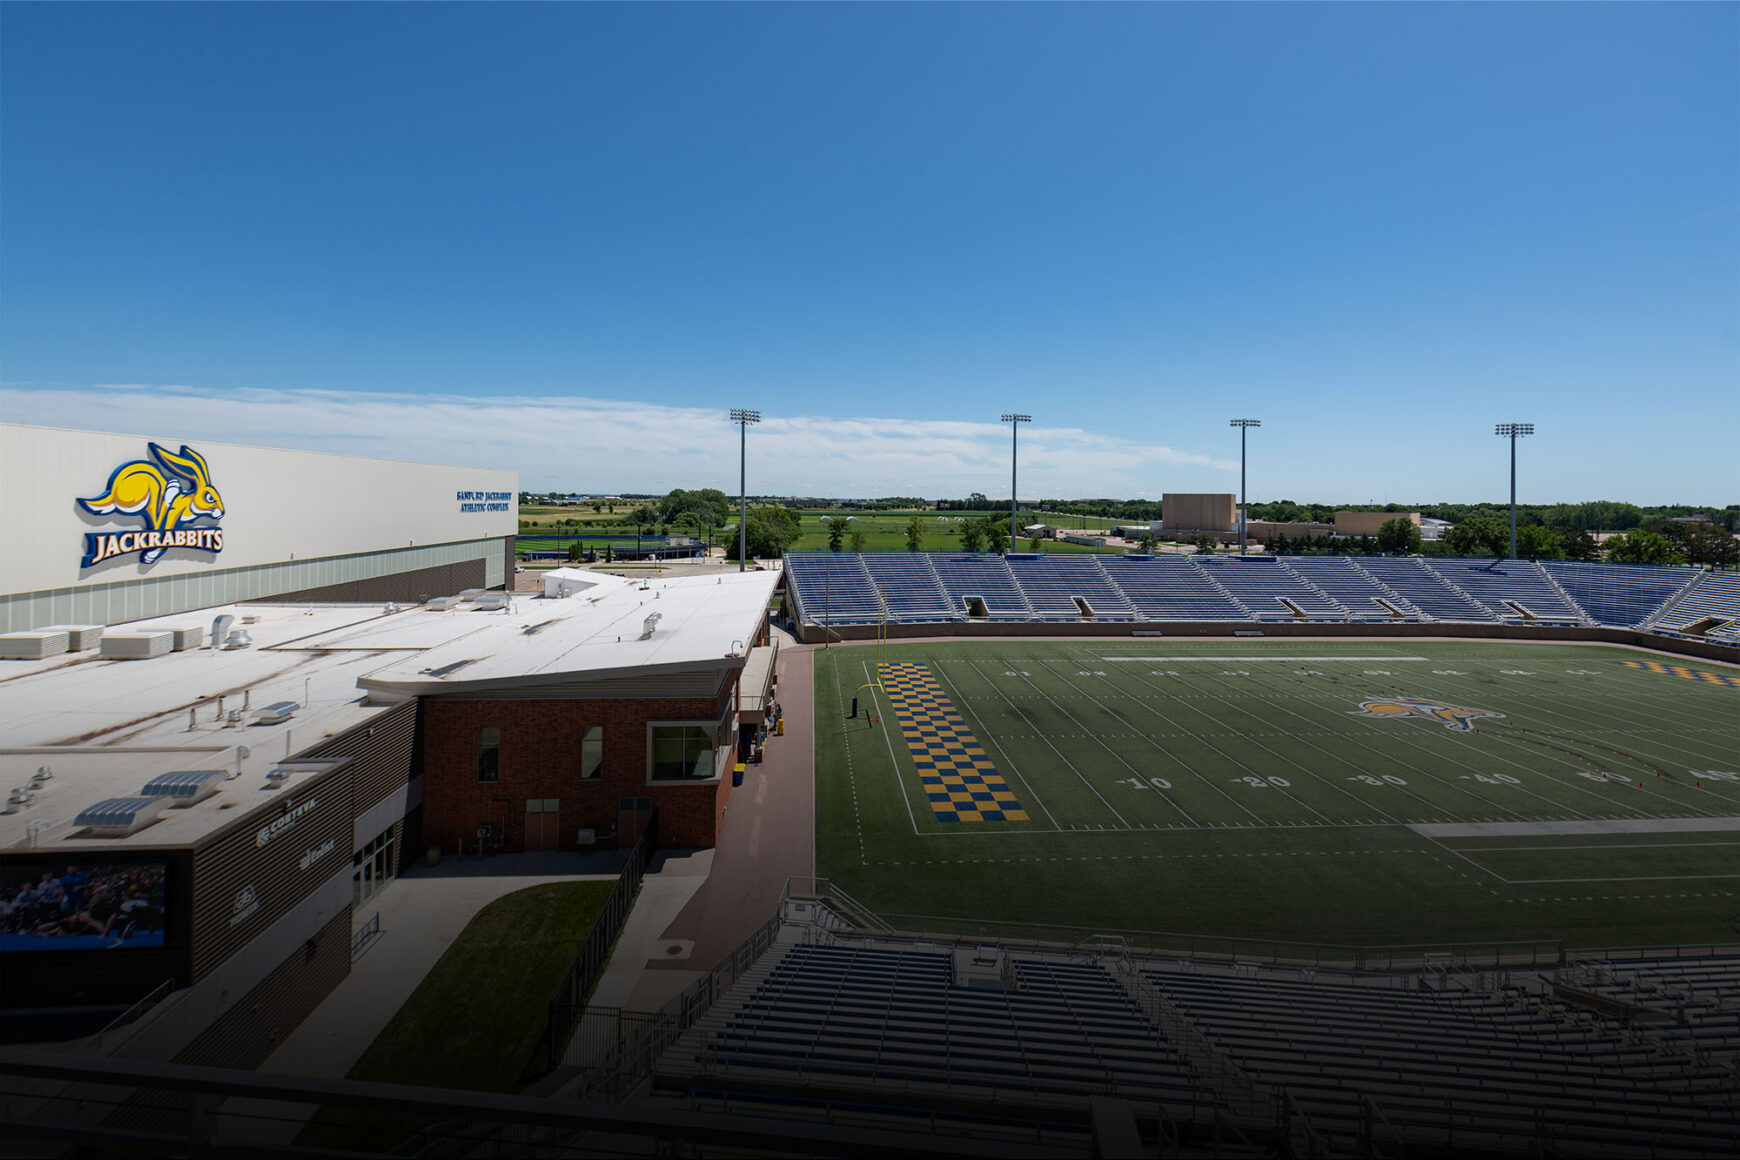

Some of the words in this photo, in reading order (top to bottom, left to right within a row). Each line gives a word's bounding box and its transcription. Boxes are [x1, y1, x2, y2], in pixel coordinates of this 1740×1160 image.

[91, 529, 222, 564] JACKRABBITS
[1127, 777, 1172, 789] 10
[1242, 776, 1291, 788] 20
[1357, 775, 1408, 786] 30
